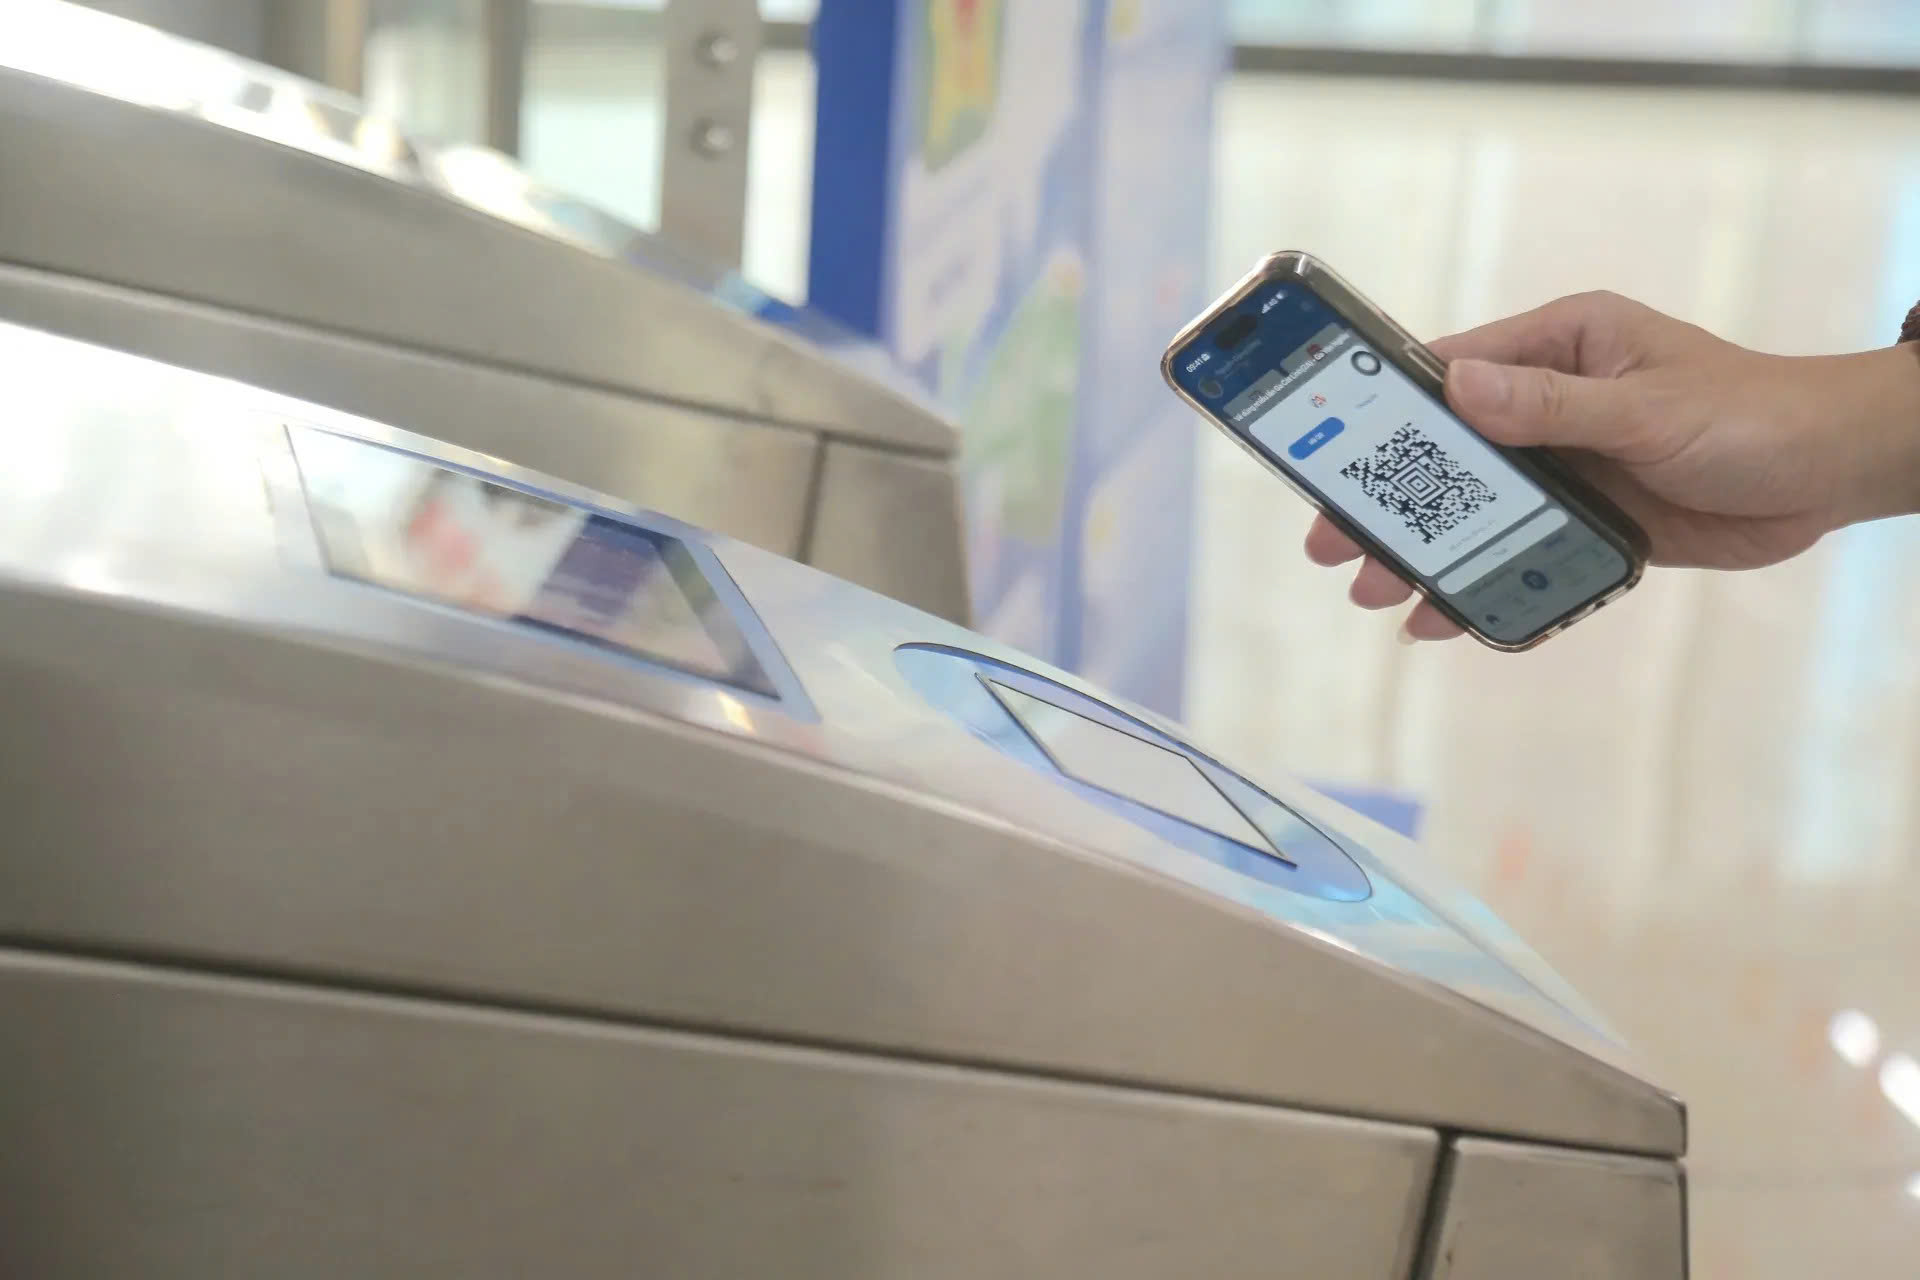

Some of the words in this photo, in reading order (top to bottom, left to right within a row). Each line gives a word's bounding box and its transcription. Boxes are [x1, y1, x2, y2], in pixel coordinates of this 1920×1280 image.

[1186, 358, 1204, 372] 09:41
[1273, 383, 1284, 392] Ga
[1314, 350, 1326, 361] Ga
